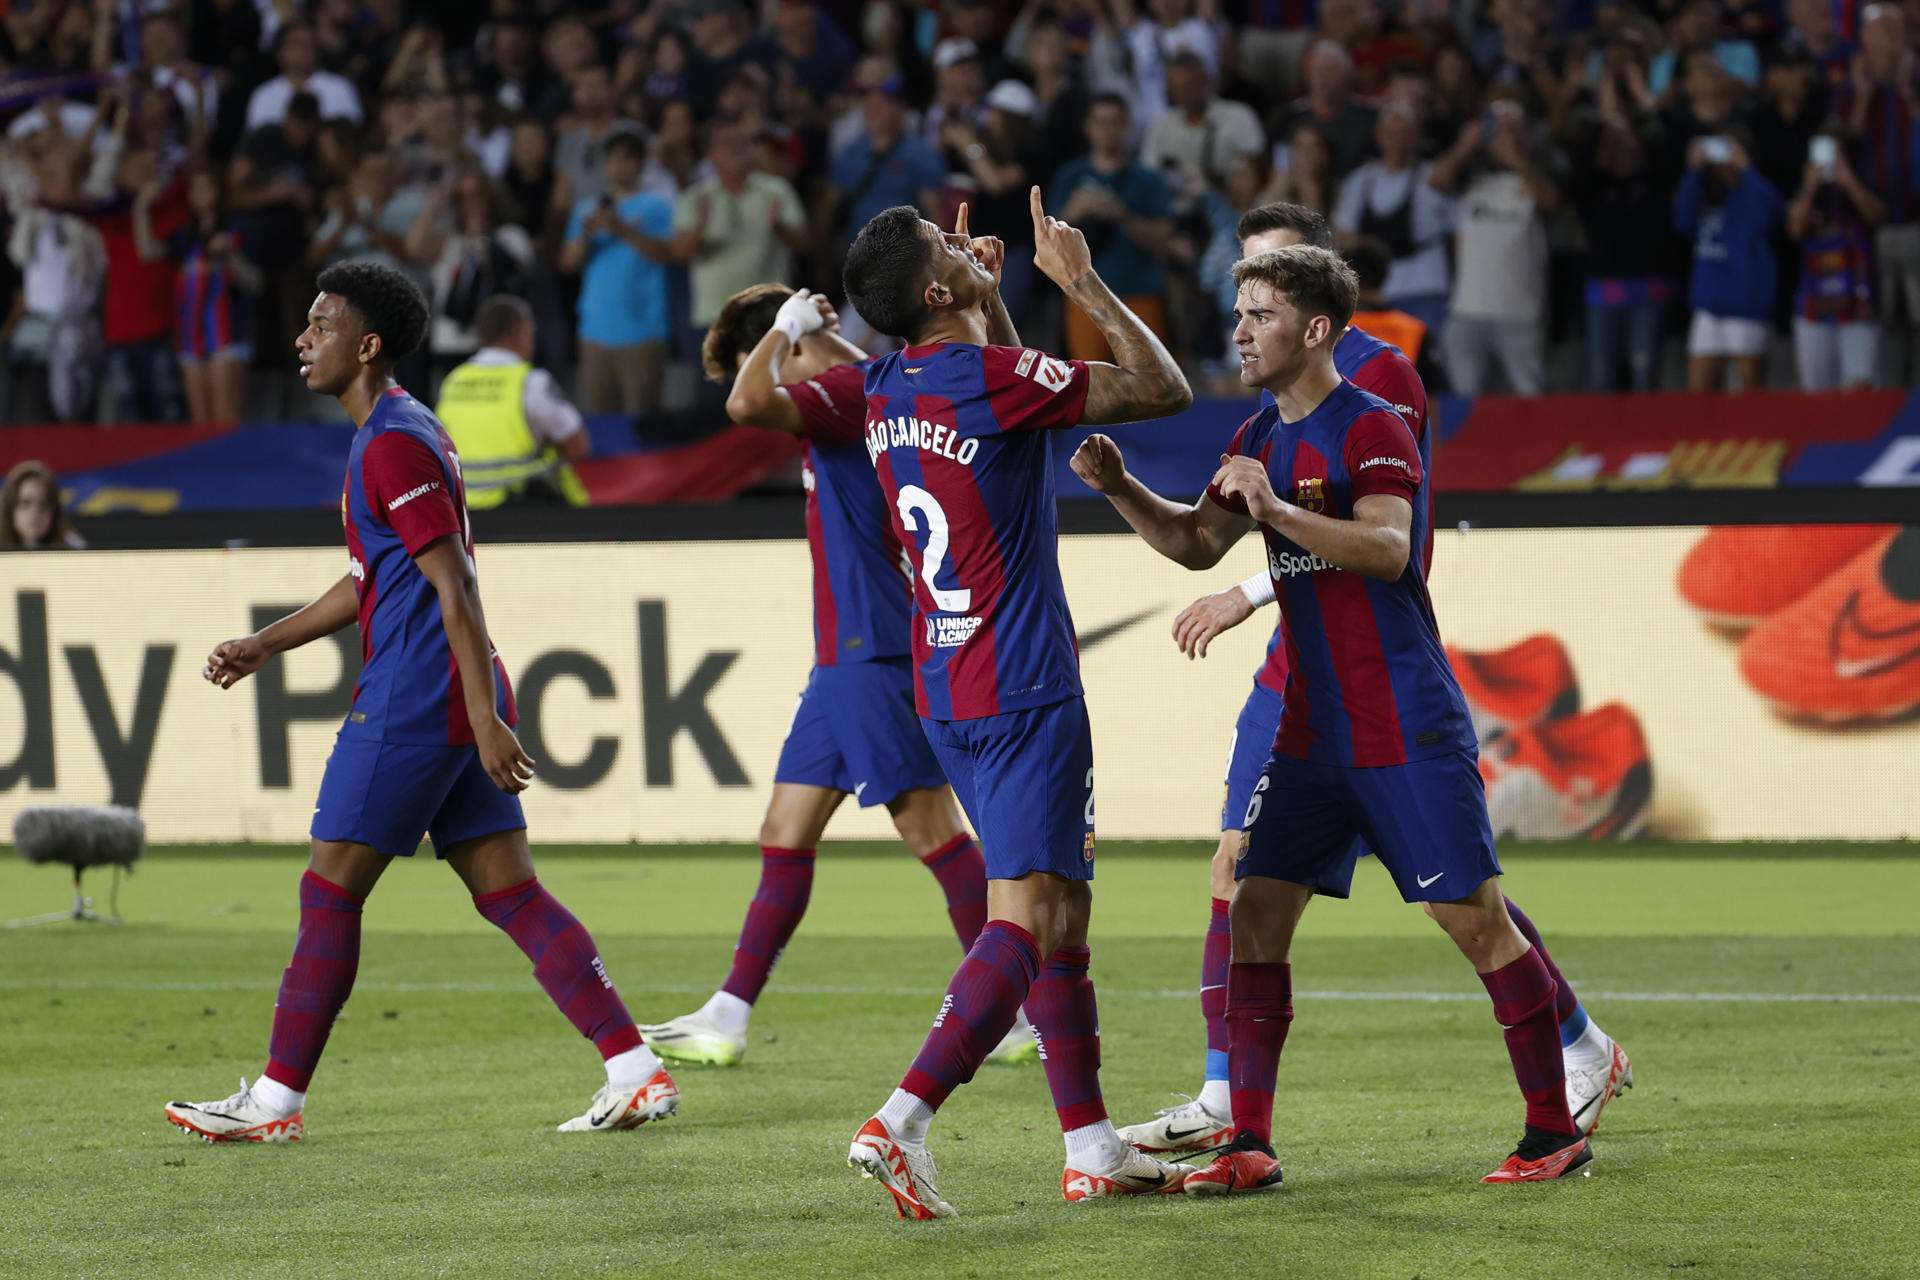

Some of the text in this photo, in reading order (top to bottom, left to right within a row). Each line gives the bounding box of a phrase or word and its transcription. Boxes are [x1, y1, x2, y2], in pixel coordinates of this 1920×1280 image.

[887, 416, 980, 465] CANCELO
[1359, 457, 1407, 470] AMBILIGHT
[896, 484, 971, 612] 2
[938, 629, 976, 643] ACNU
[249, 598, 753, 790] Pck
[1243, 774, 1270, 828] 6
[933, 994, 954, 1029] BARÇA
